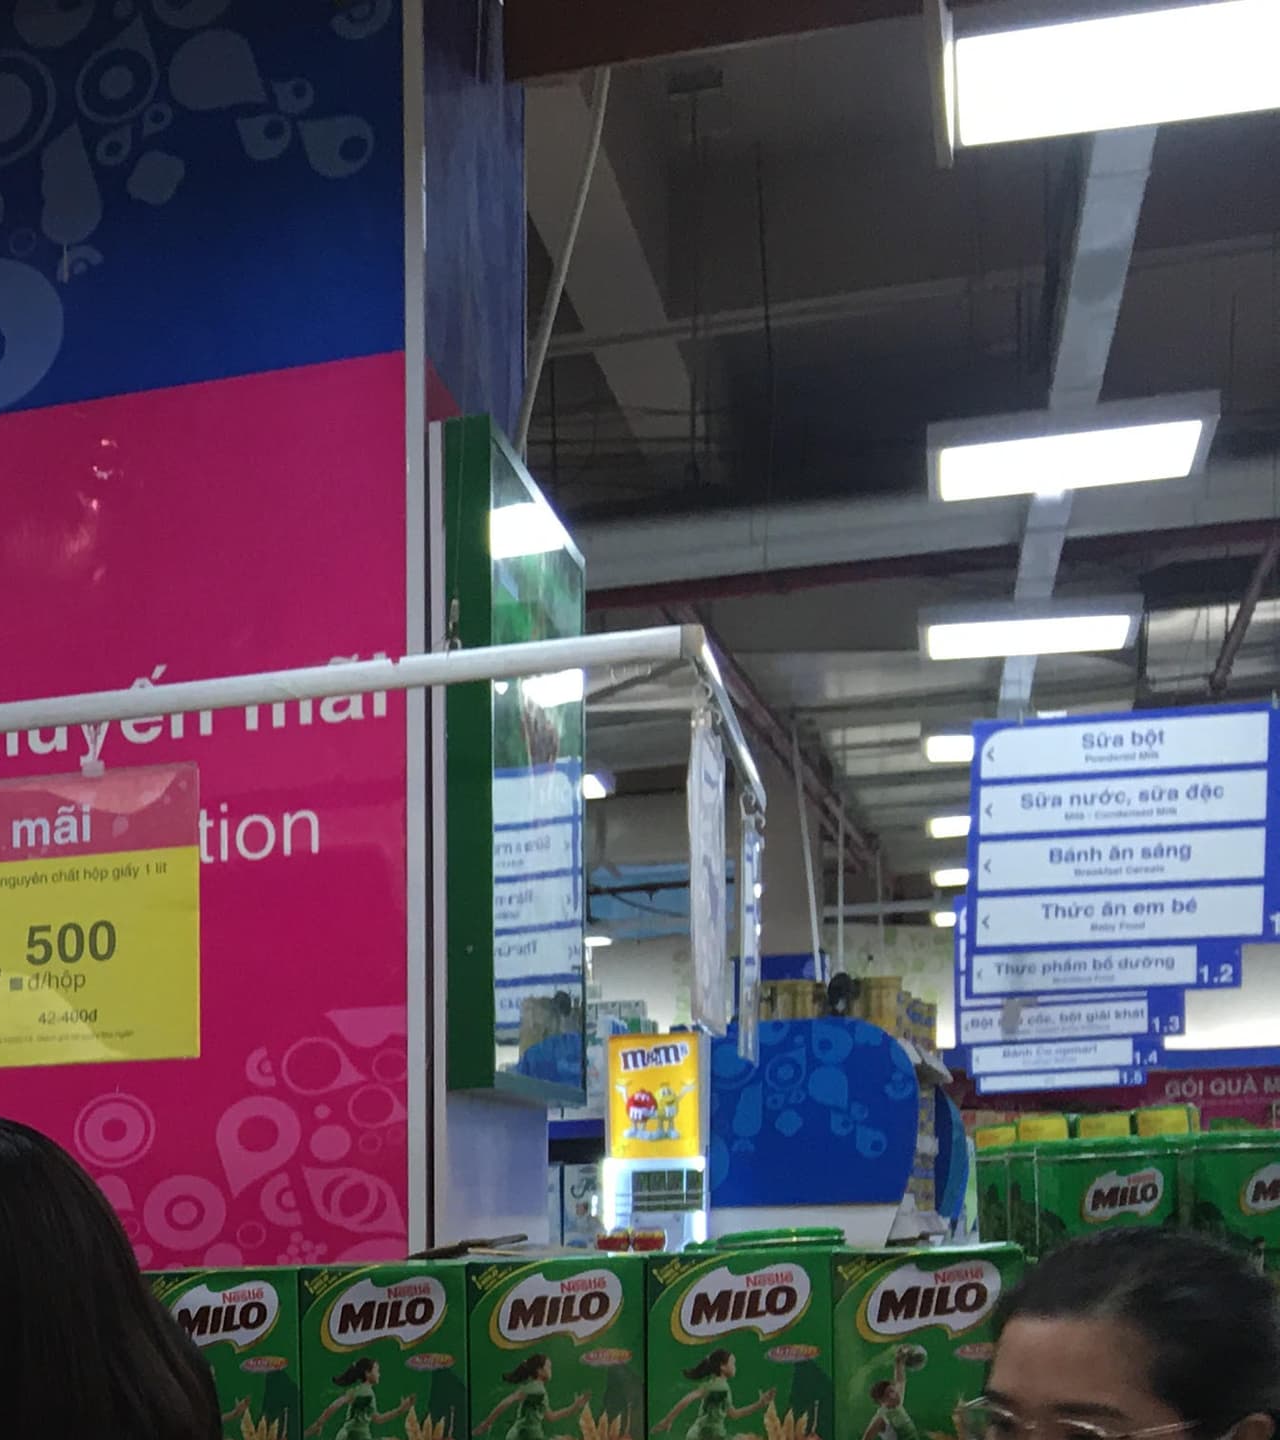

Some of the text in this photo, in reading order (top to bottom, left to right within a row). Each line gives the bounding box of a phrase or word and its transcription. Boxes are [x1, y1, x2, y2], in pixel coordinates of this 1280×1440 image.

[1081, 728, 1165, 750] Sữa bột
[1020, 782, 1224, 809] Sữa nước, sữa đặc
[10, 804, 94, 851] mãi
[1048, 841, 1192, 865] Bánh ăn sáng
[0, 873, 48, 890] nguyên
[51, 866, 81, 884] chất
[83, 866, 109, 884] hộp
[111, 863, 140, 882] giấy
[1041, 896, 1198, 920] Thức ăn em bé
[25, 919, 117, 966] 500
[28, 969, 87, 993] đ/hộp
[1199, 963, 1234, 984] 1.2
[1151, 1015, 1181, 1033] 1.3
[1165, 1079, 1204, 1098] GÓI
[1210, 1074, 1258, 1096] QUÀ
[1091, 1183, 1158, 1211] MILO
[338, 1297, 435, 1335] MILO
[507, 1291, 610, 1331] MILO
[690, 1286, 798, 1327] MILO
[876, 1282, 989, 1324] MILO
[178, 1303, 268, 1338] MILO
